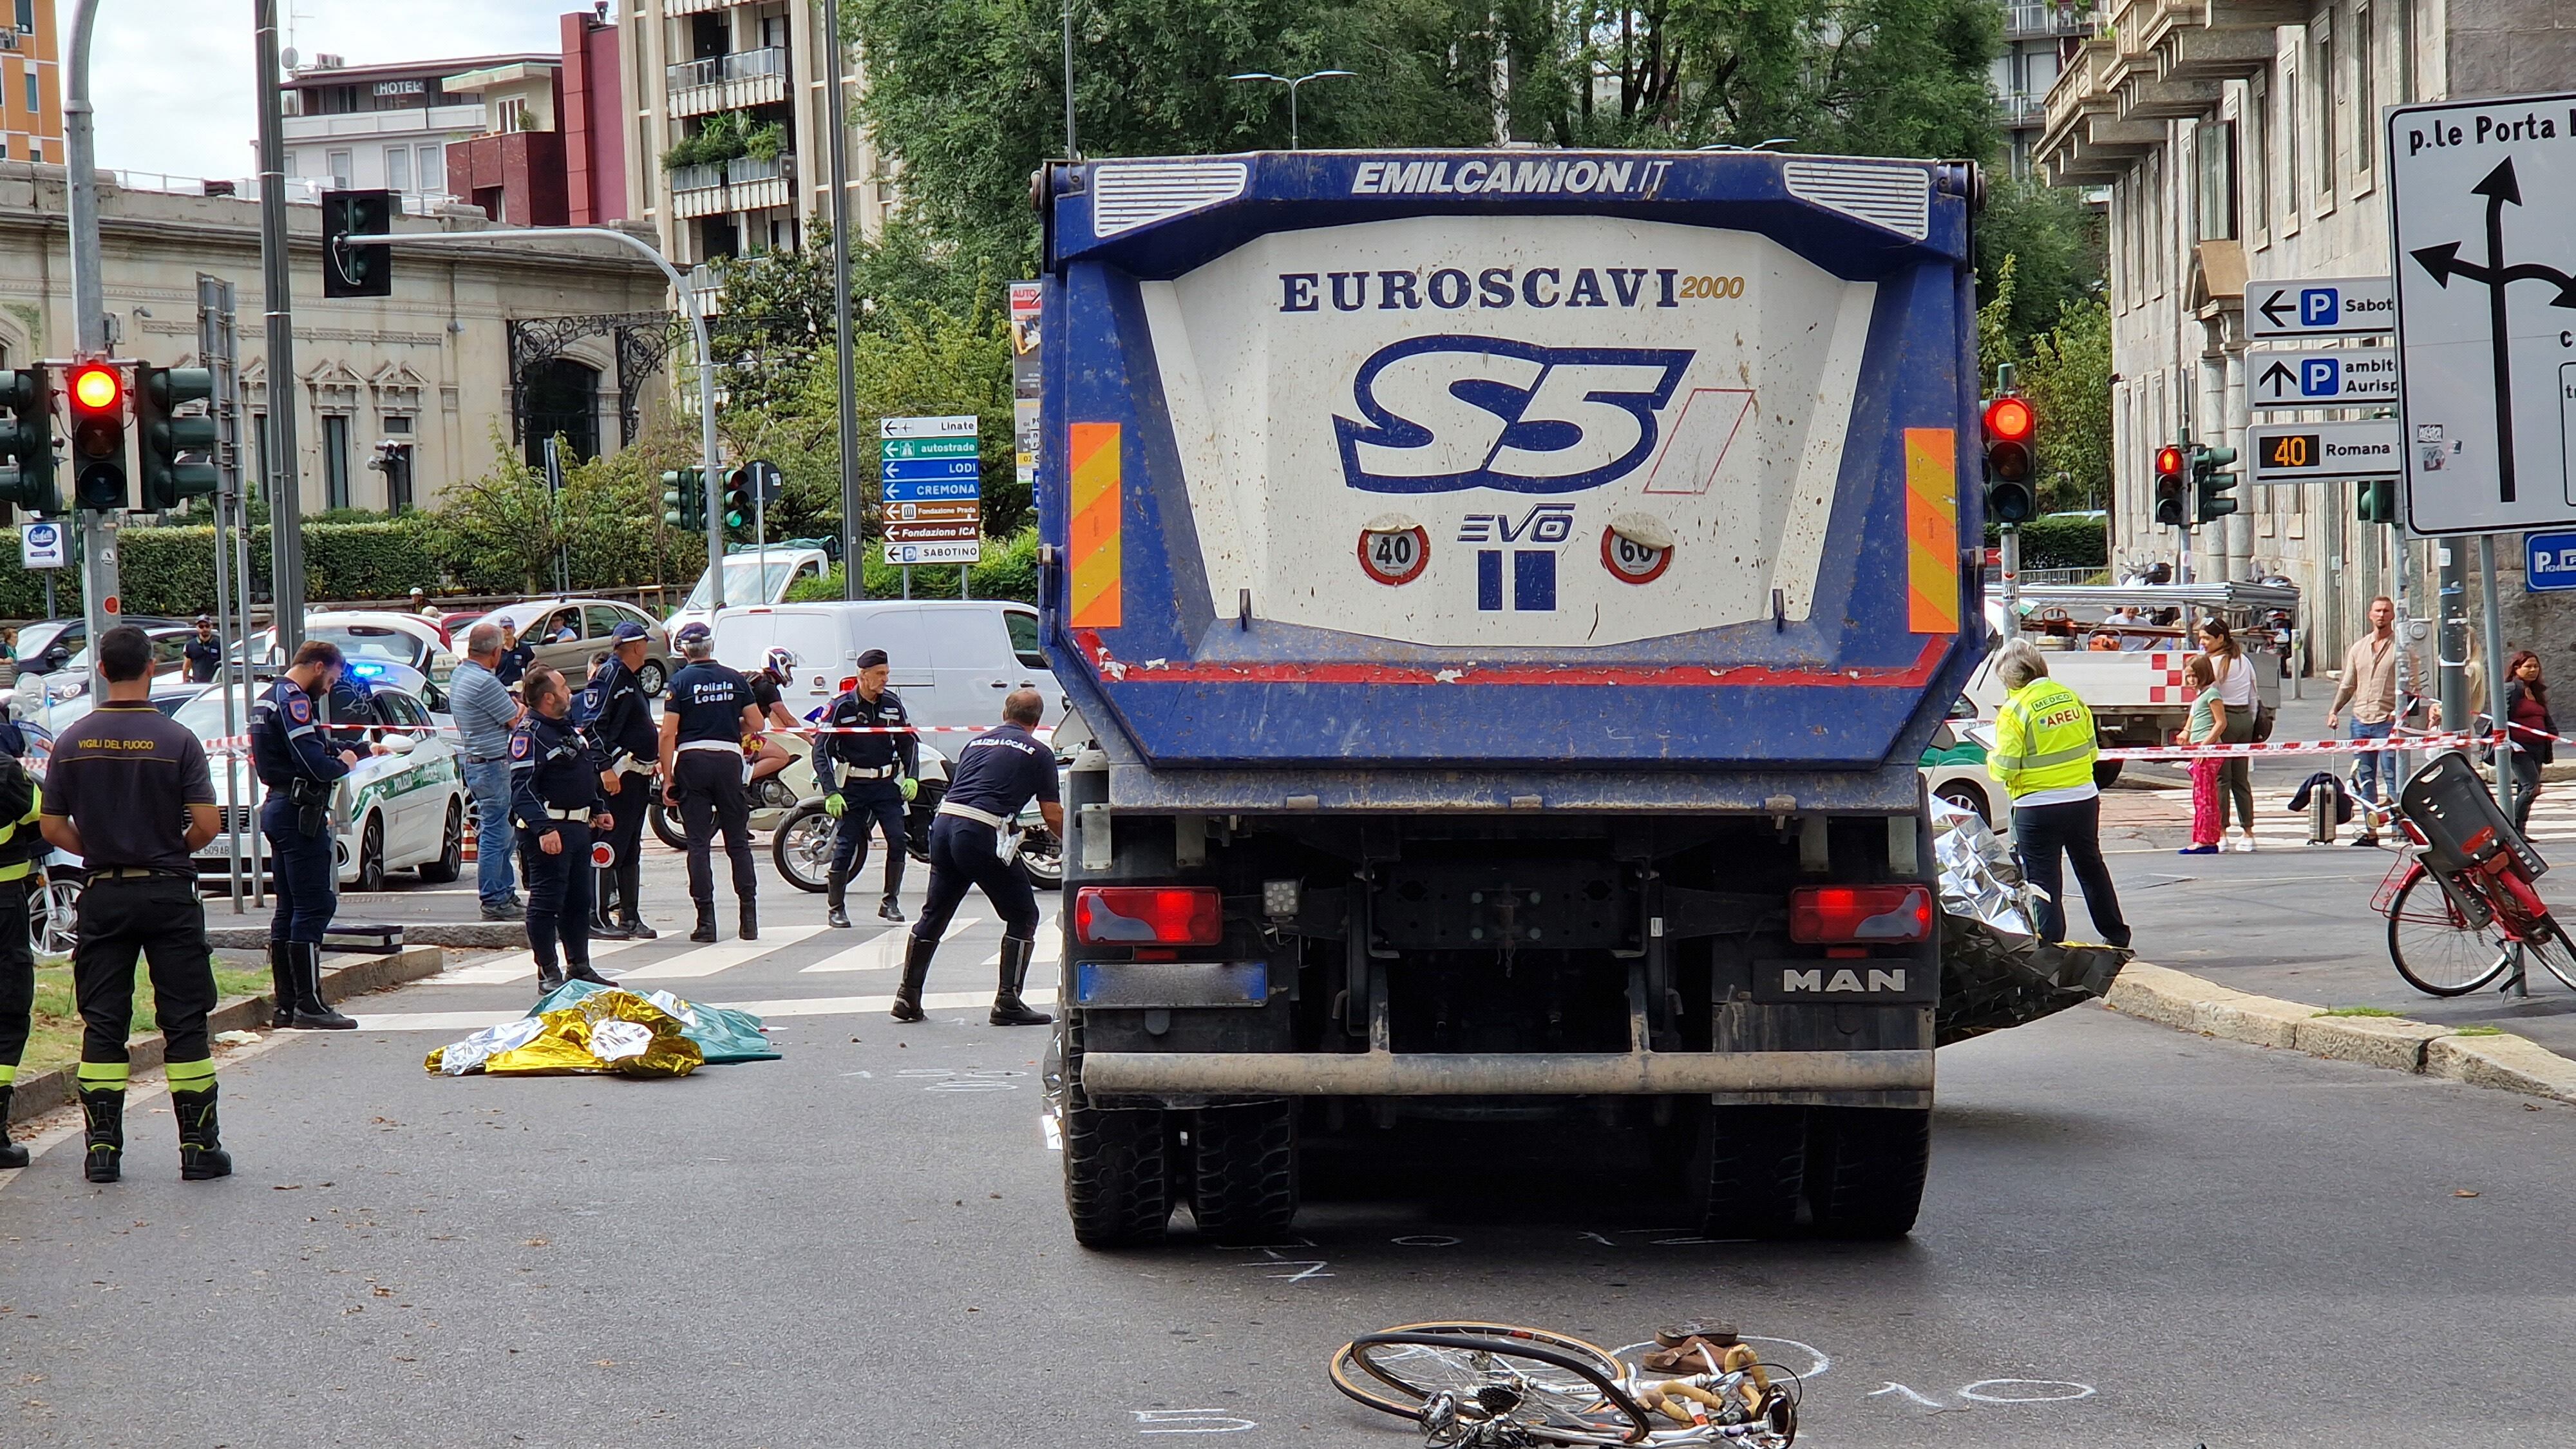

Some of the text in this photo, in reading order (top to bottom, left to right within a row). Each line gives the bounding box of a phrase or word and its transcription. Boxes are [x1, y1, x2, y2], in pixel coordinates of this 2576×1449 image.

[379, 81, 421, 94] HOTEL
[2409, 120, 2463, 156] p.le
[2476, 112, 2556, 144] Porta
[1351, 160, 1674, 194] EMILCAMION.IT
[1013, 289, 1036, 298] AUTO
[1279, 268, 1745, 312] EUROSCAVI 2000
[2345, 359, 2396, 372] ambit
[941, 422, 974, 431] Linate
[921, 442, 975, 453] autostrade
[2275, 437, 2306, 466] 40
[2326, 443, 2391, 457] Romana
[949, 463, 976, 473] LODI
[916, 484, 976, 495] CREMONA
[902, 527, 976, 538] Fondazione ICA
[923, 548, 977, 556] SABOTINO
[1376, 536, 1411, 564] 40
[1620, 538, 1653, 562] 60
[694, 681, 734, 694] Polizia
[695, 691, 734, 704] Locale
[2035, 694, 2070, 709] MEDICO
[2047, 708, 2080, 728] AREU
[78, 739, 154, 750] VIGILI DEL FUOCO
[1000, 738, 1036, 755] LOCALE
[1783, 969, 1906, 992] MAN
